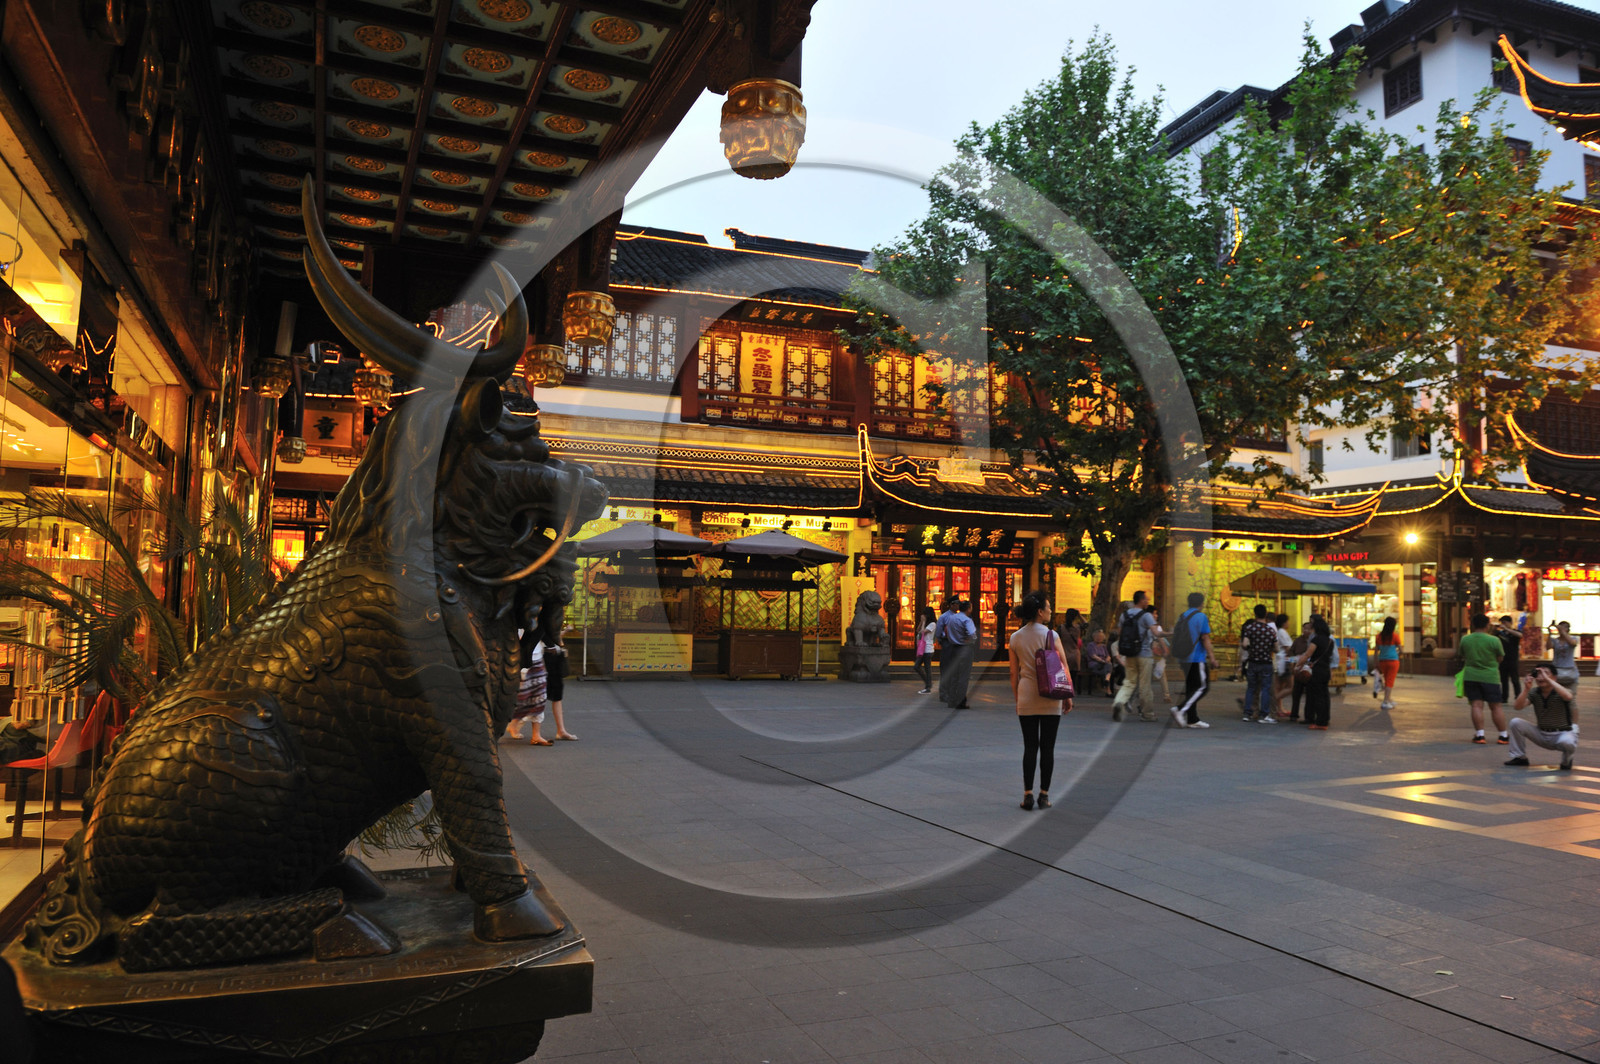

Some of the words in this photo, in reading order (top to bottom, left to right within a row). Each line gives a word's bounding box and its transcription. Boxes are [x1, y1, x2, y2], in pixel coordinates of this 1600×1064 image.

[752, 347, 773, 405] 冬蟲夏
[313, 416, 339, 439] 童
[704, 513, 748, 524] Chines
[753, 516, 800, 527] Medice
[806, 518, 848, 529] Musum
[1251, 573, 1278, 591] Kodak
